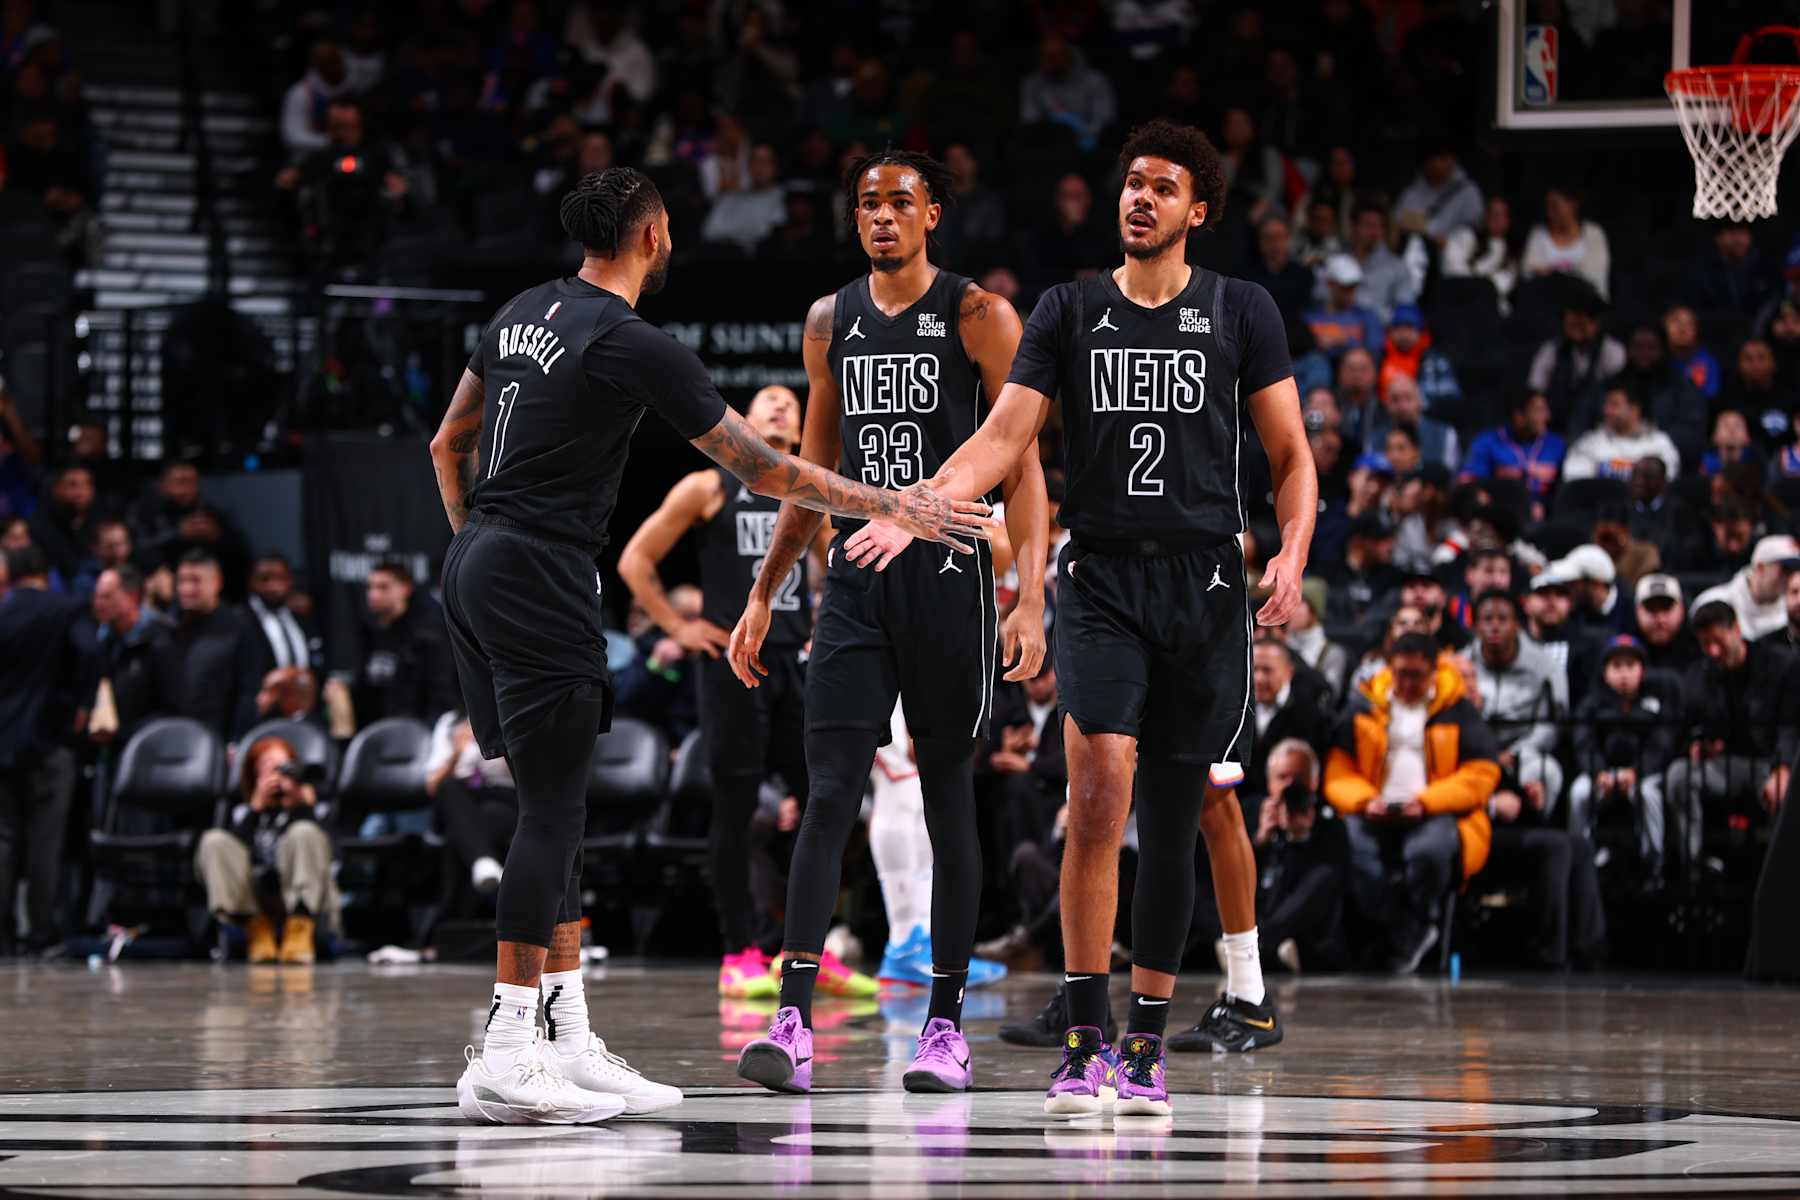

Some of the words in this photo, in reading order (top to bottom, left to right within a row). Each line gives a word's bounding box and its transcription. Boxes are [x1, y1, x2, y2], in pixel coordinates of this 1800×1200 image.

[916, 328, 946, 337] GUIDE
[918, 313, 937, 322] GET
[918, 320, 946, 330] YOUR
[1178, 323, 1211, 334] GUIDE
[1180, 307, 1200, 317] GET
[1180, 315, 1210, 326] YOUR
[499, 323, 566, 376] RUSSELL
[842, 353, 940, 417] NETS
[1091, 348, 1207, 414] NETS
[486, 380, 521, 480] 1
[858, 421, 924, 492] 33
[1127, 422, 1166, 496] 2
[736, 511, 779, 556] NE
